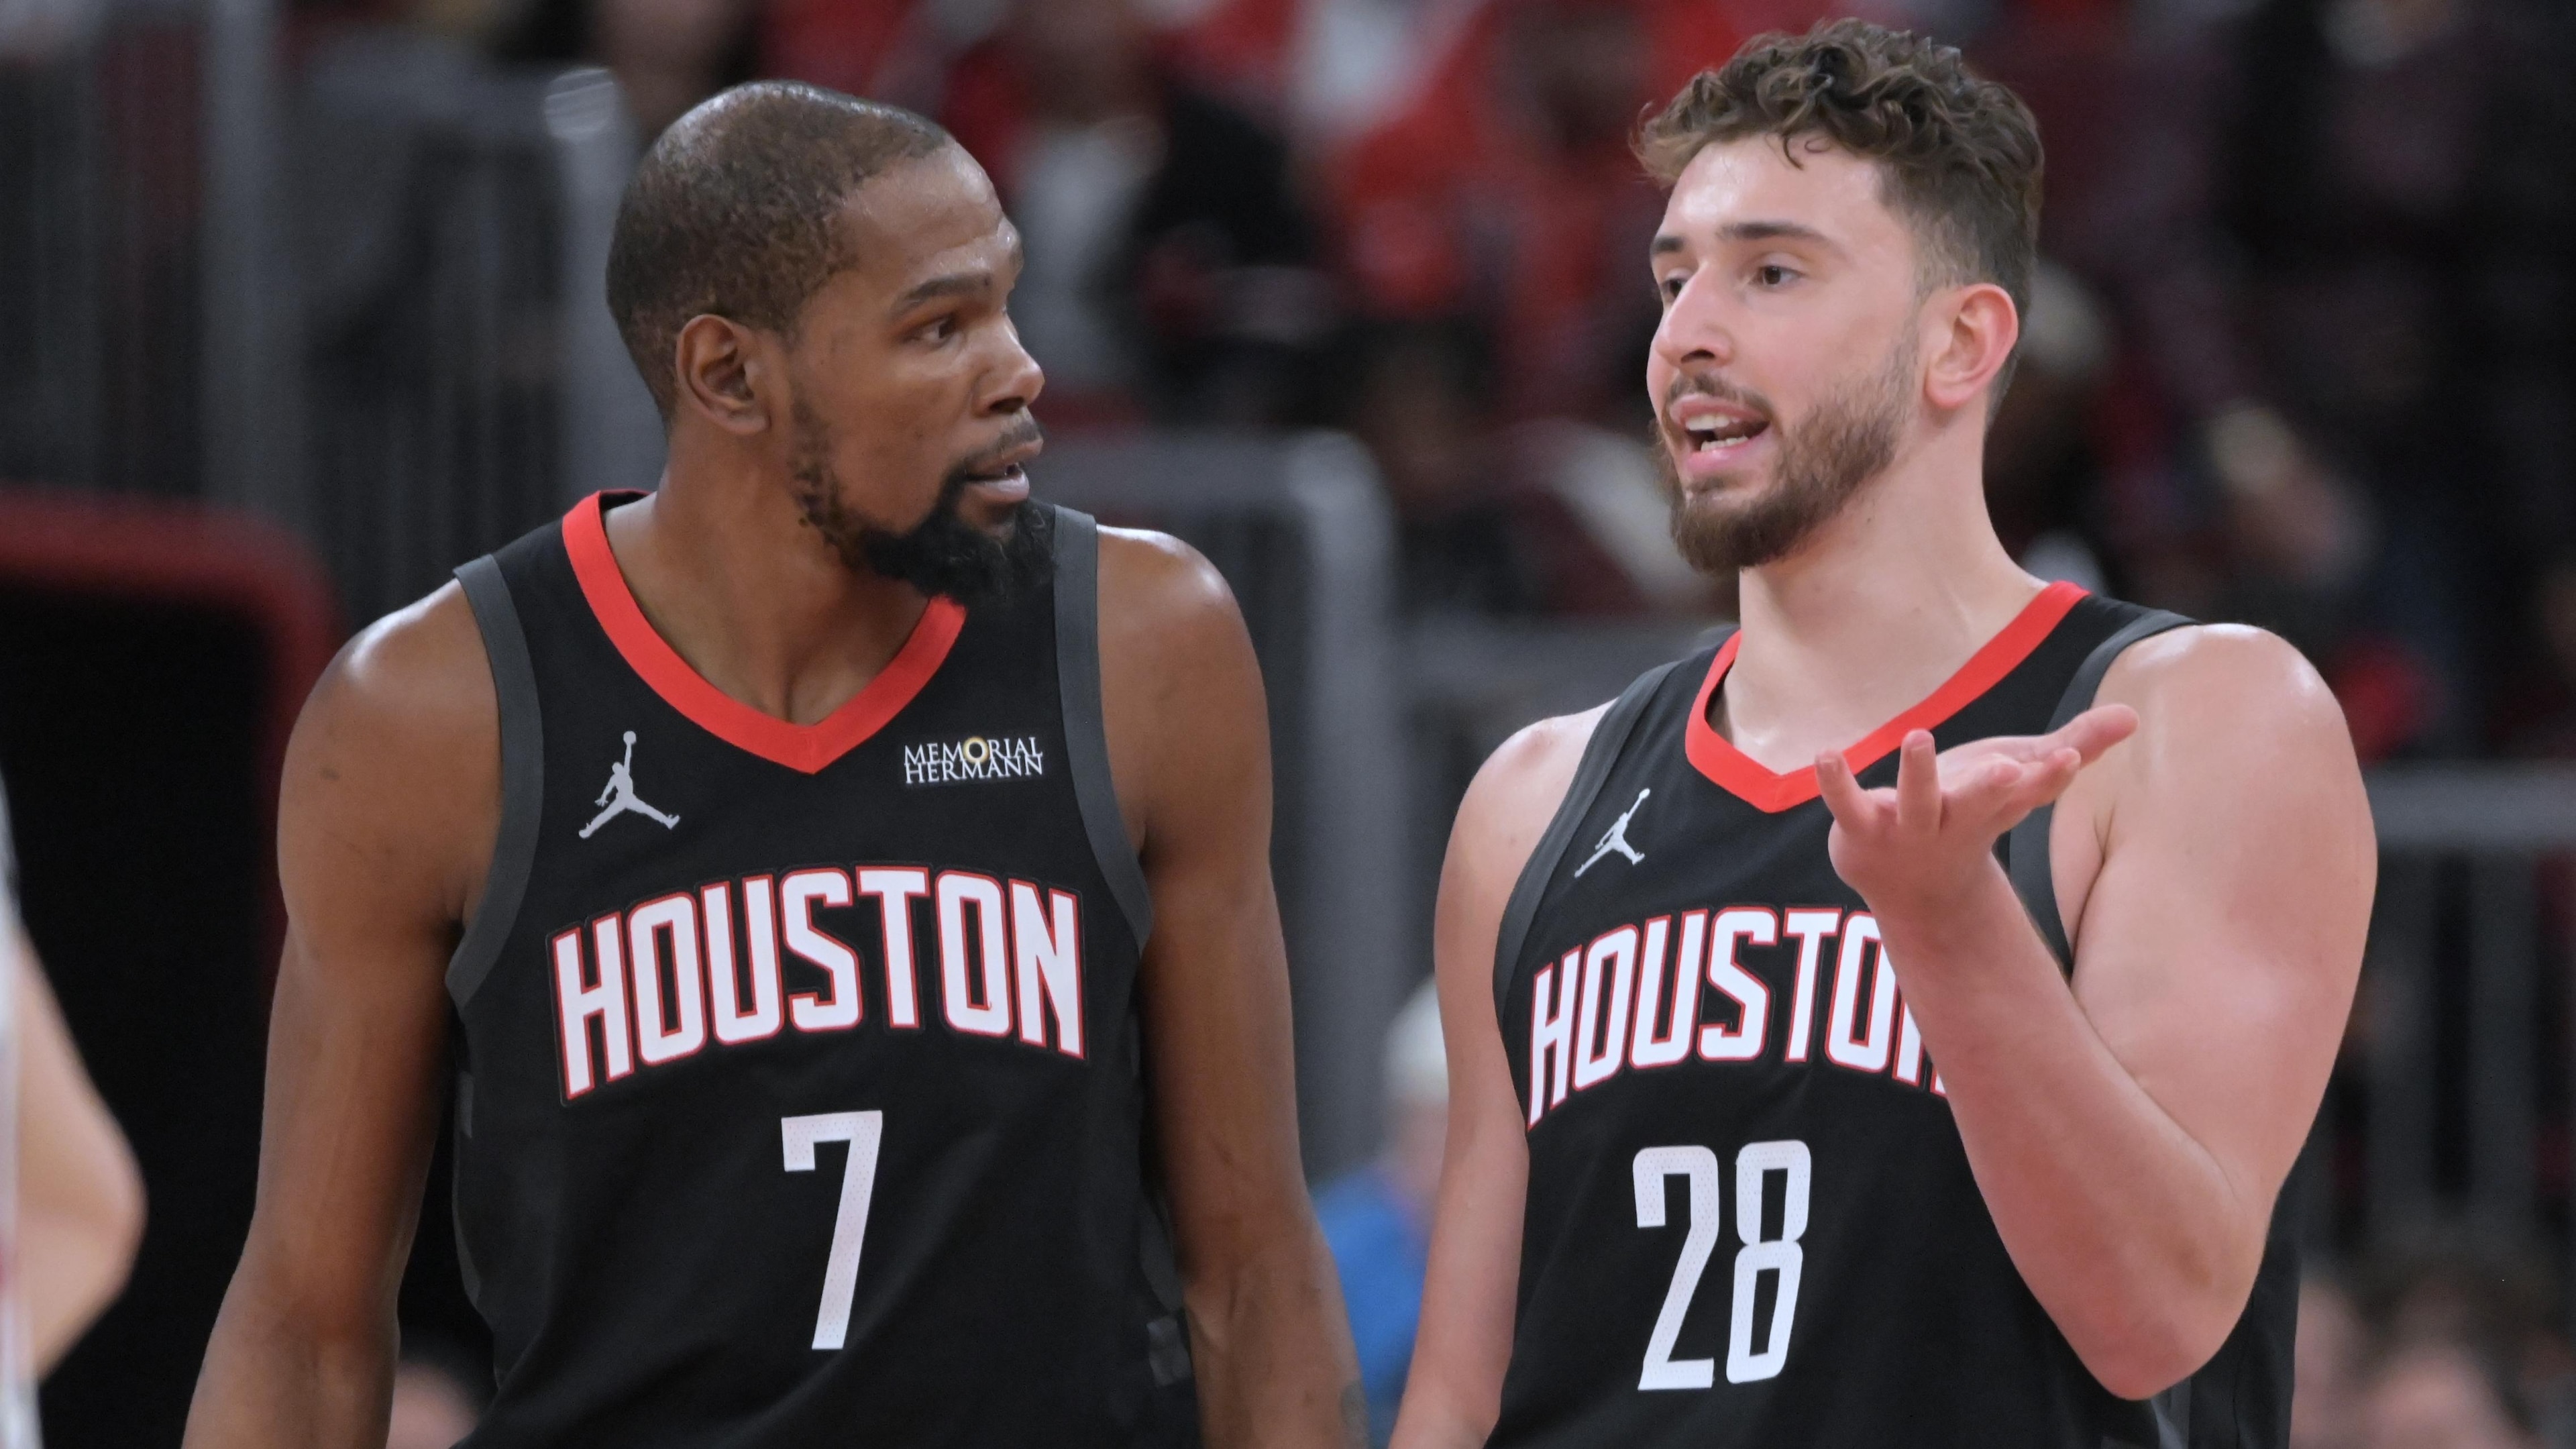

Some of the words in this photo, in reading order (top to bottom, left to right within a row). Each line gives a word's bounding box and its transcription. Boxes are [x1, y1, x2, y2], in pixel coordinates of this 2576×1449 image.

[904, 736, 1042, 765] MEMORIAL
[906, 755, 1042, 784] HERMANN
[550, 865, 1084, 1101] HOUSTON
[781, 1110, 883, 1350] 7
[1633, 1139, 1811, 1391] 28
